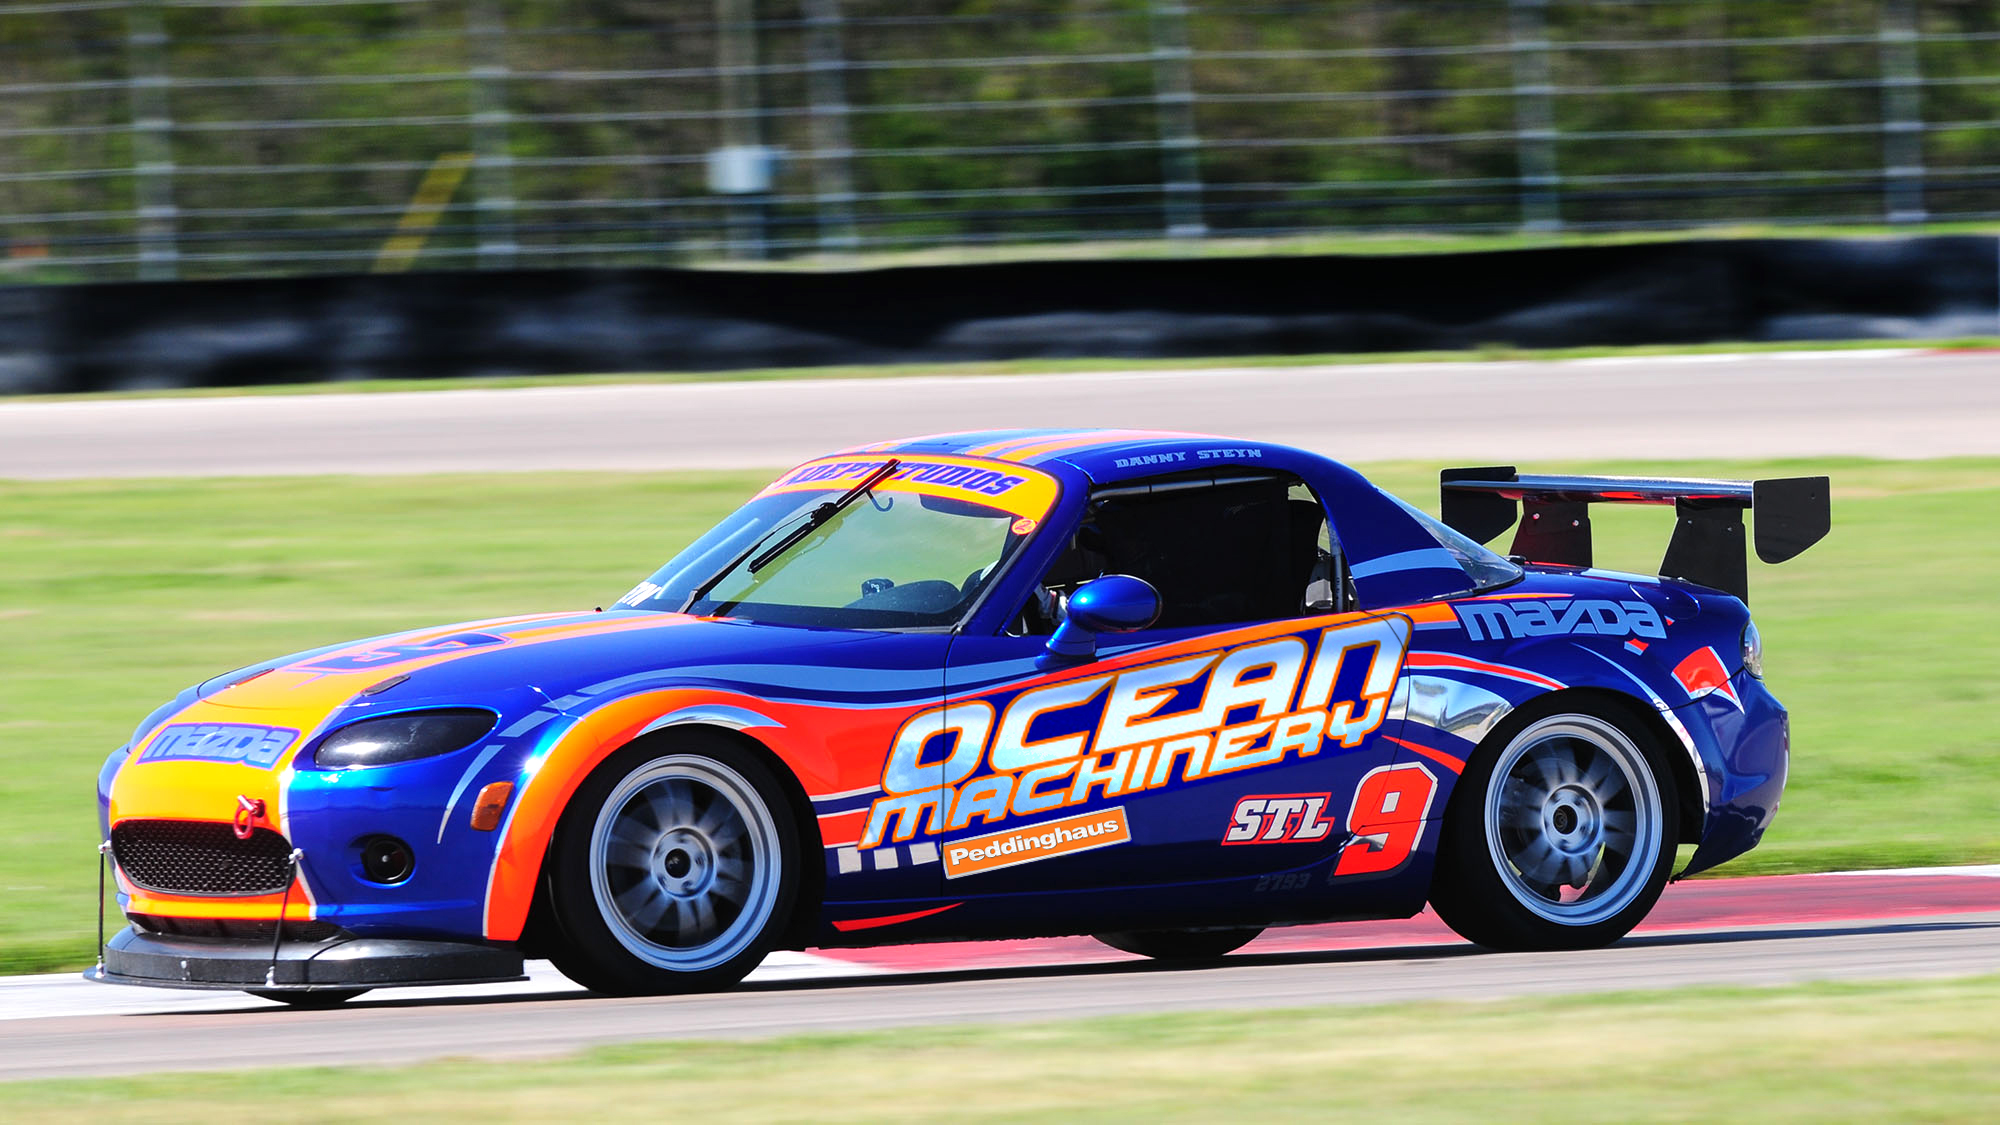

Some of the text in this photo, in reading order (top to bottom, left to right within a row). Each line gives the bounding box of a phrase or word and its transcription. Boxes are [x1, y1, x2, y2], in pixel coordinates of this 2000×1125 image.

[889, 462, 1029, 496] TUDIOS
[1113, 448, 1263, 468] DANNY STEYN
[880, 611, 1413, 796] OCEAN
[858, 693, 1389, 850] MACHINERY
[949, 820, 1119, 866] Peddinghaus
[1224, 795, 1332, 843] STL
[1331, 763, 1437, 880] 9
